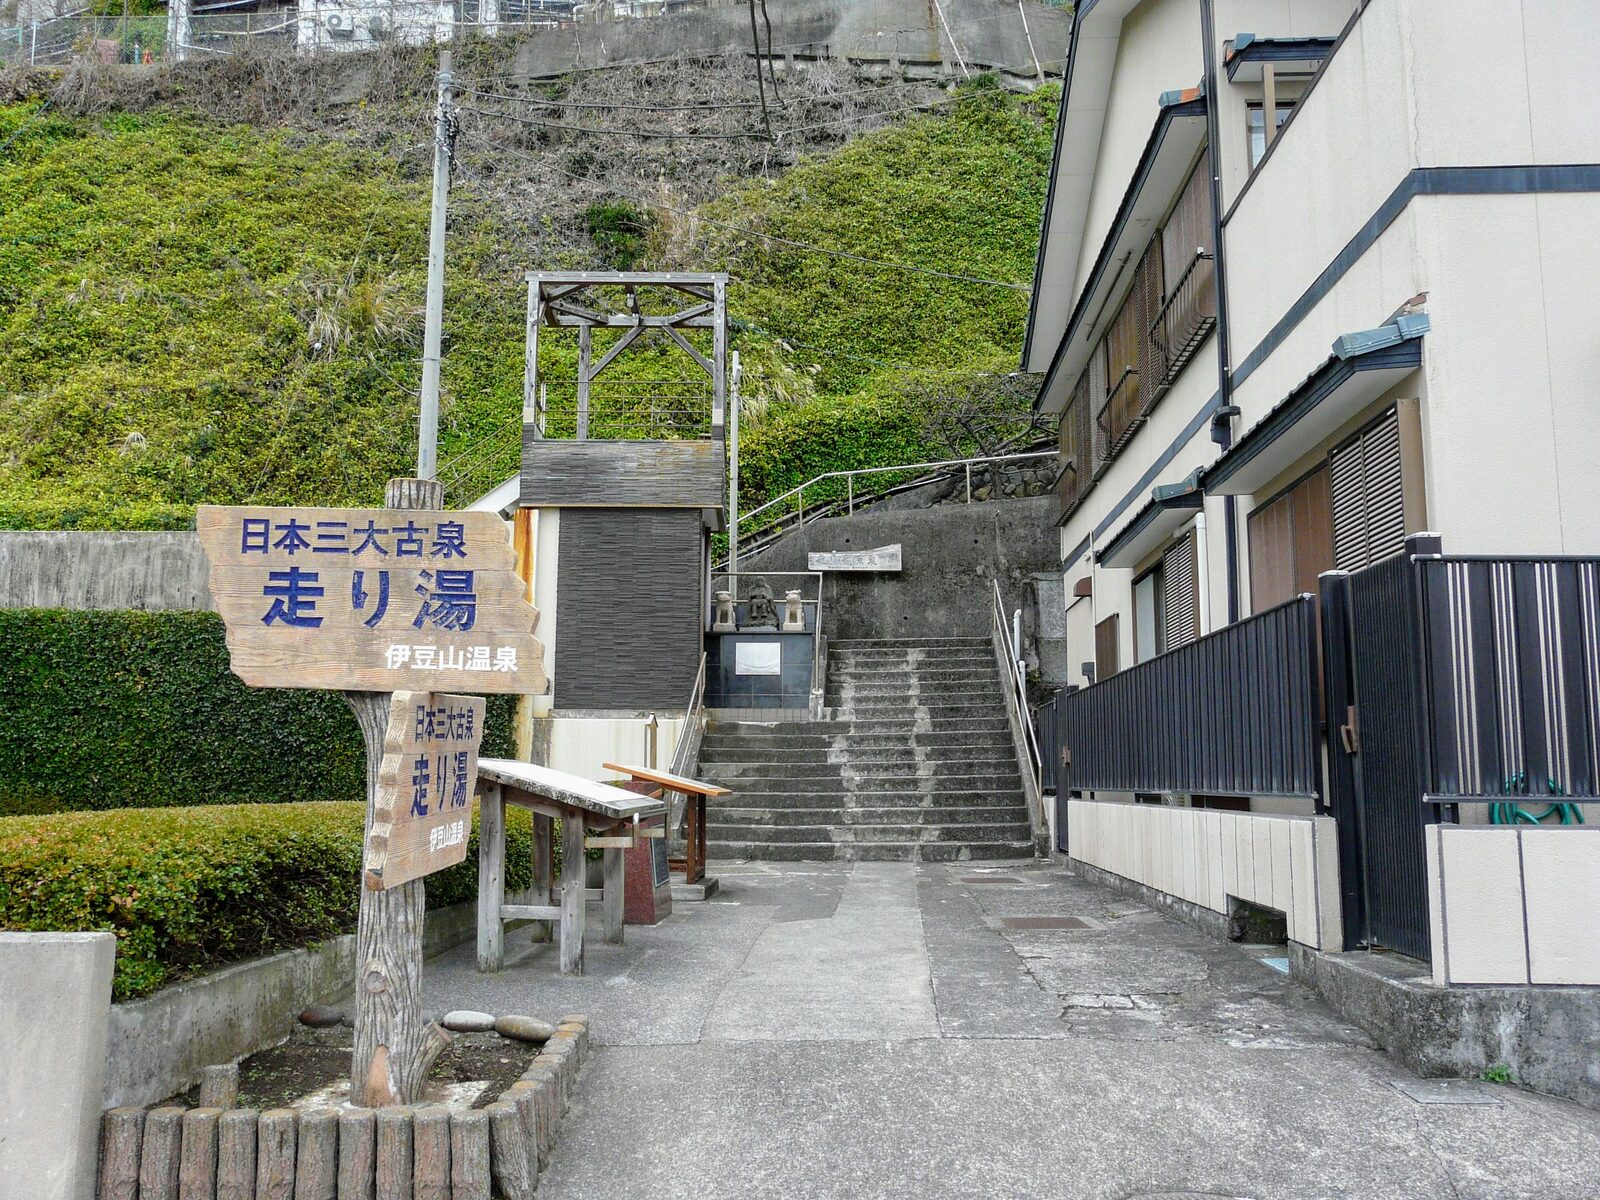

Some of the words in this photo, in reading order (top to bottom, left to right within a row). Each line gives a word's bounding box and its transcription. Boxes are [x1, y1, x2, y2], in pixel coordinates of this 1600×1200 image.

[241, 518, 468, 558] 日本三大古泉
[262, 567, 477, 631] 走り湯
[385, 645, 518, 672] 伊豆山温泉
[415, 705, 473, 742] 日本三大古泉
[411, 752, 468, 818] 走り湯
[430, 821, 463, 851] 伊豆山温泉
